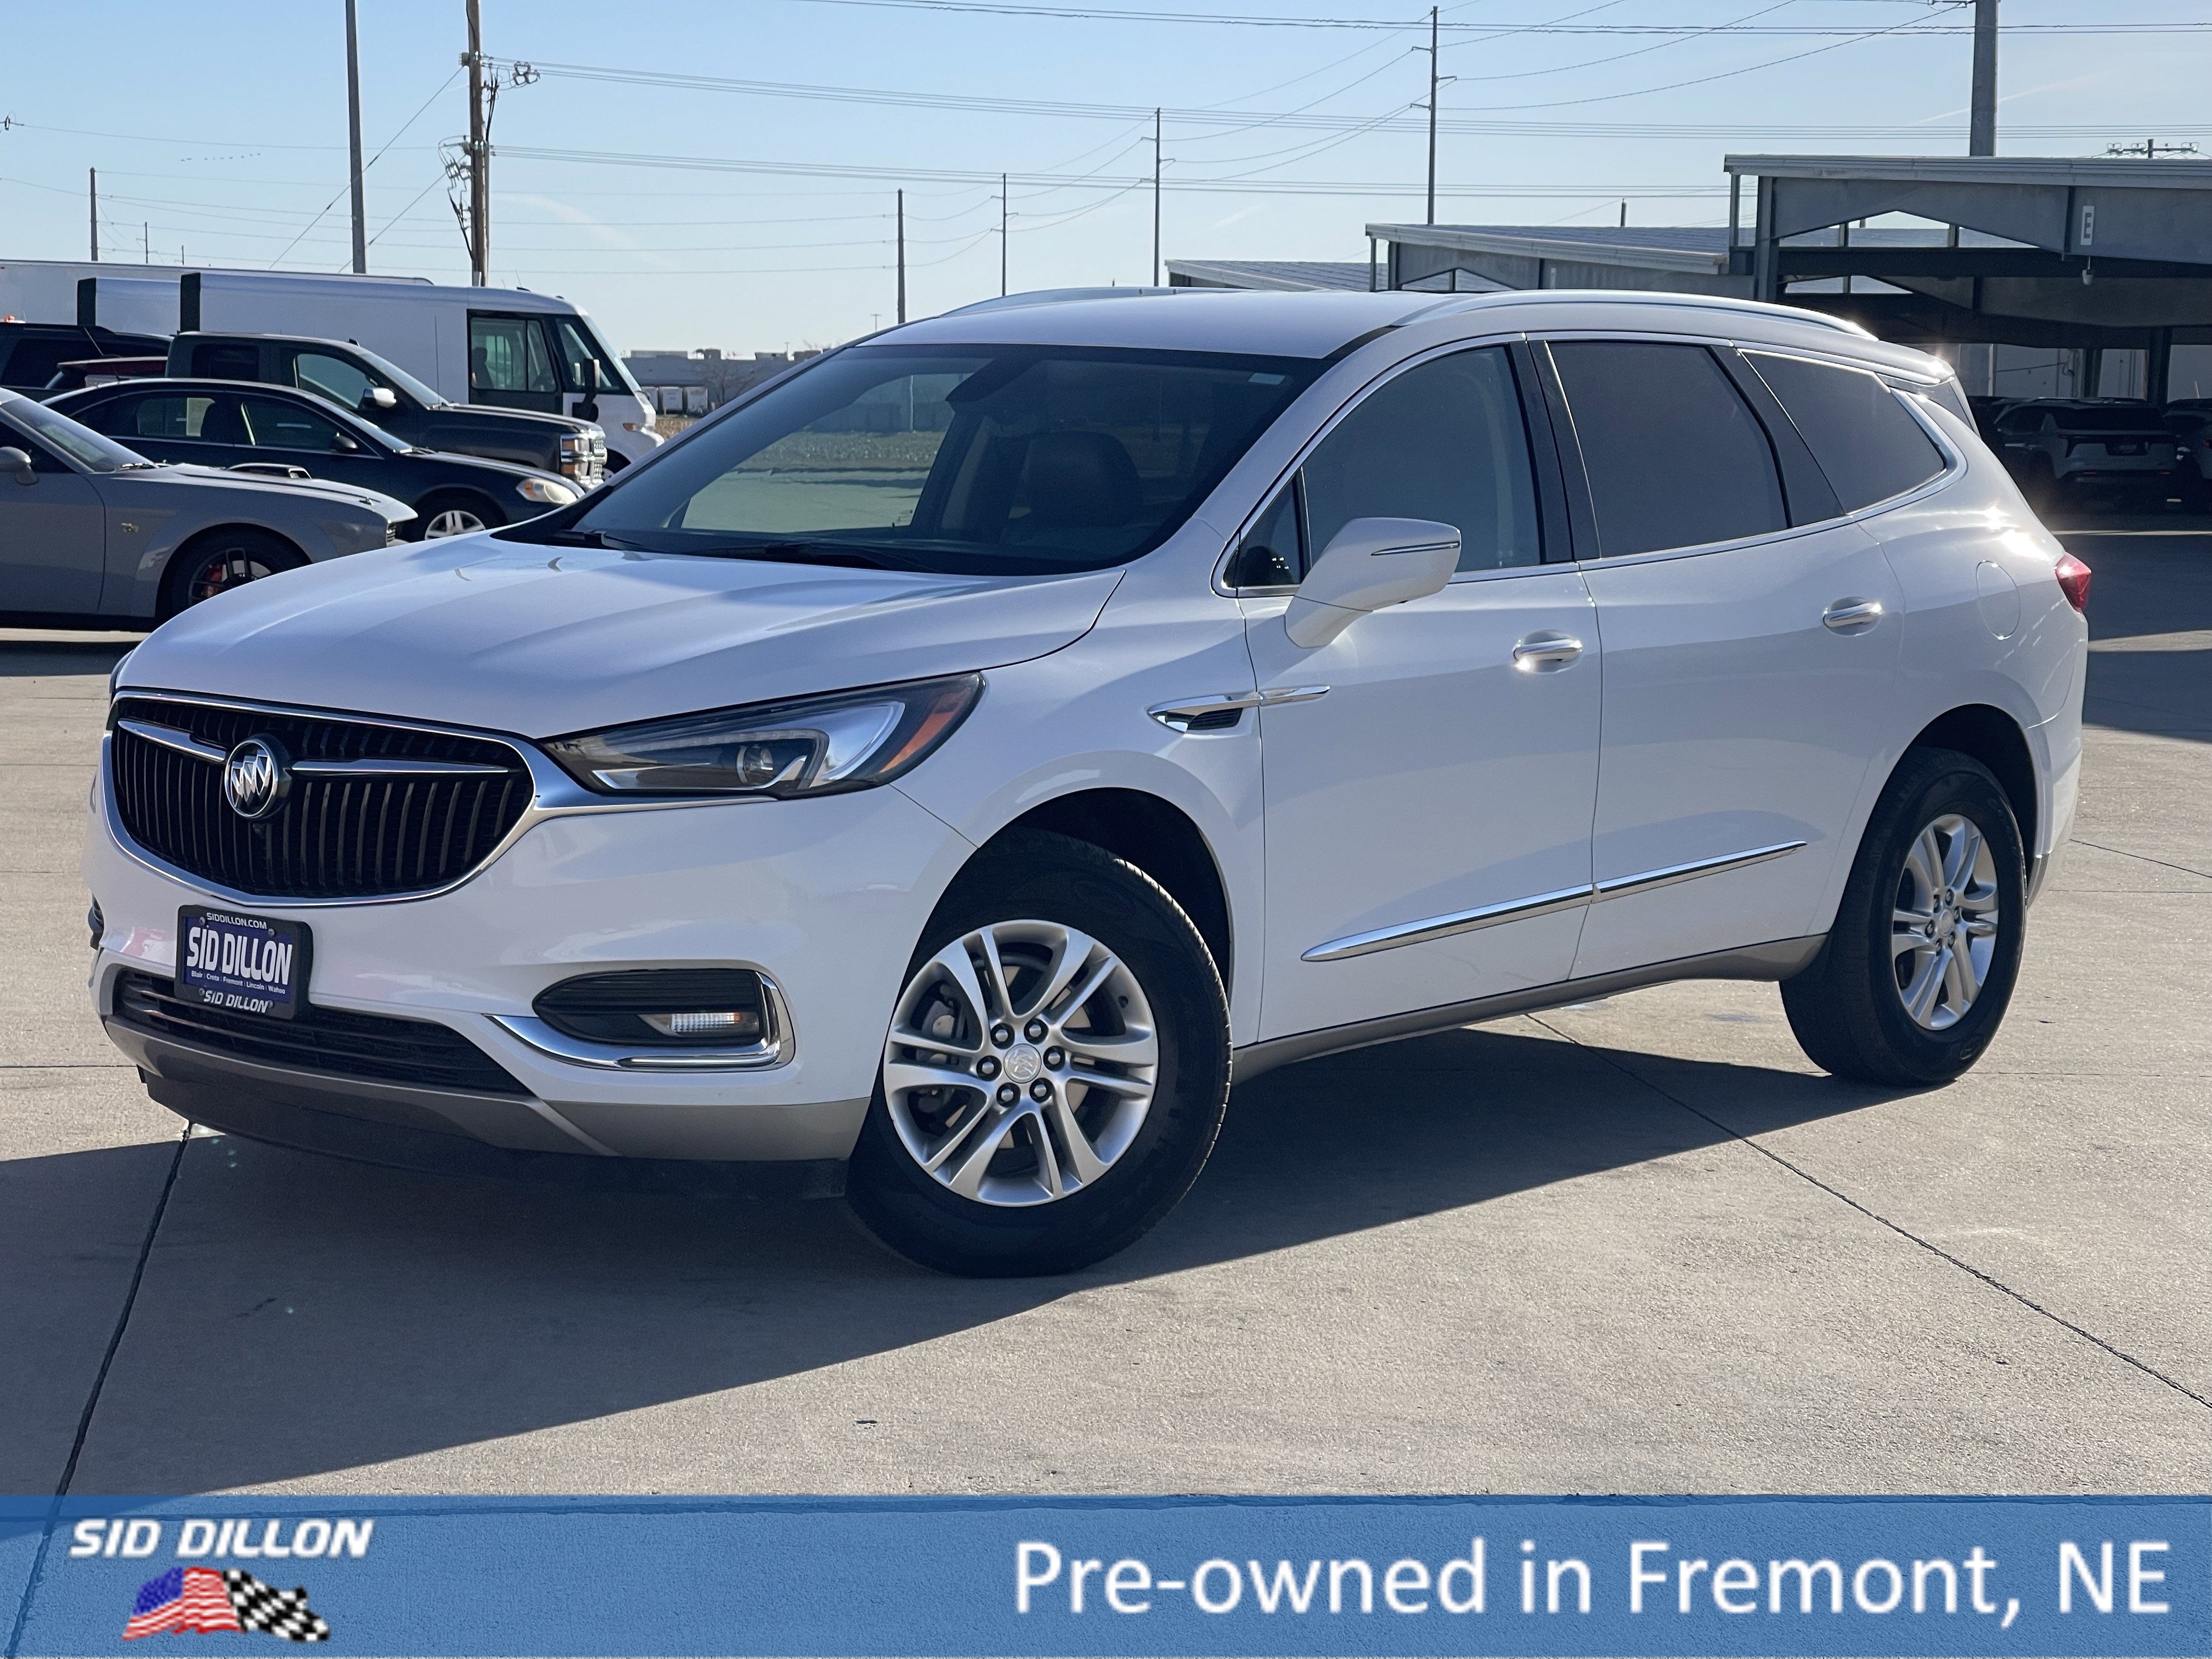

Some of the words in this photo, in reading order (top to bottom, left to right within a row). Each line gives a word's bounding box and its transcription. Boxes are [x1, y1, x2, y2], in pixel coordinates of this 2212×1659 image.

[2084, 212, 2092, 239] E
[206, 912, 267, 929] SIDDILLON.COM
[187, 927, 219, 971] SID
[222, 933, 292, 985] DILLON
[206, 973, 219, 981] Crete
[223, 976, 243, 986] Fremont
[246, 981, 265, 990] Lincoln
[268, 985, 286, 995] Wahoo
[204, 990, 224, 1005] SID
[225, 994, 269, 1013] DILLON
